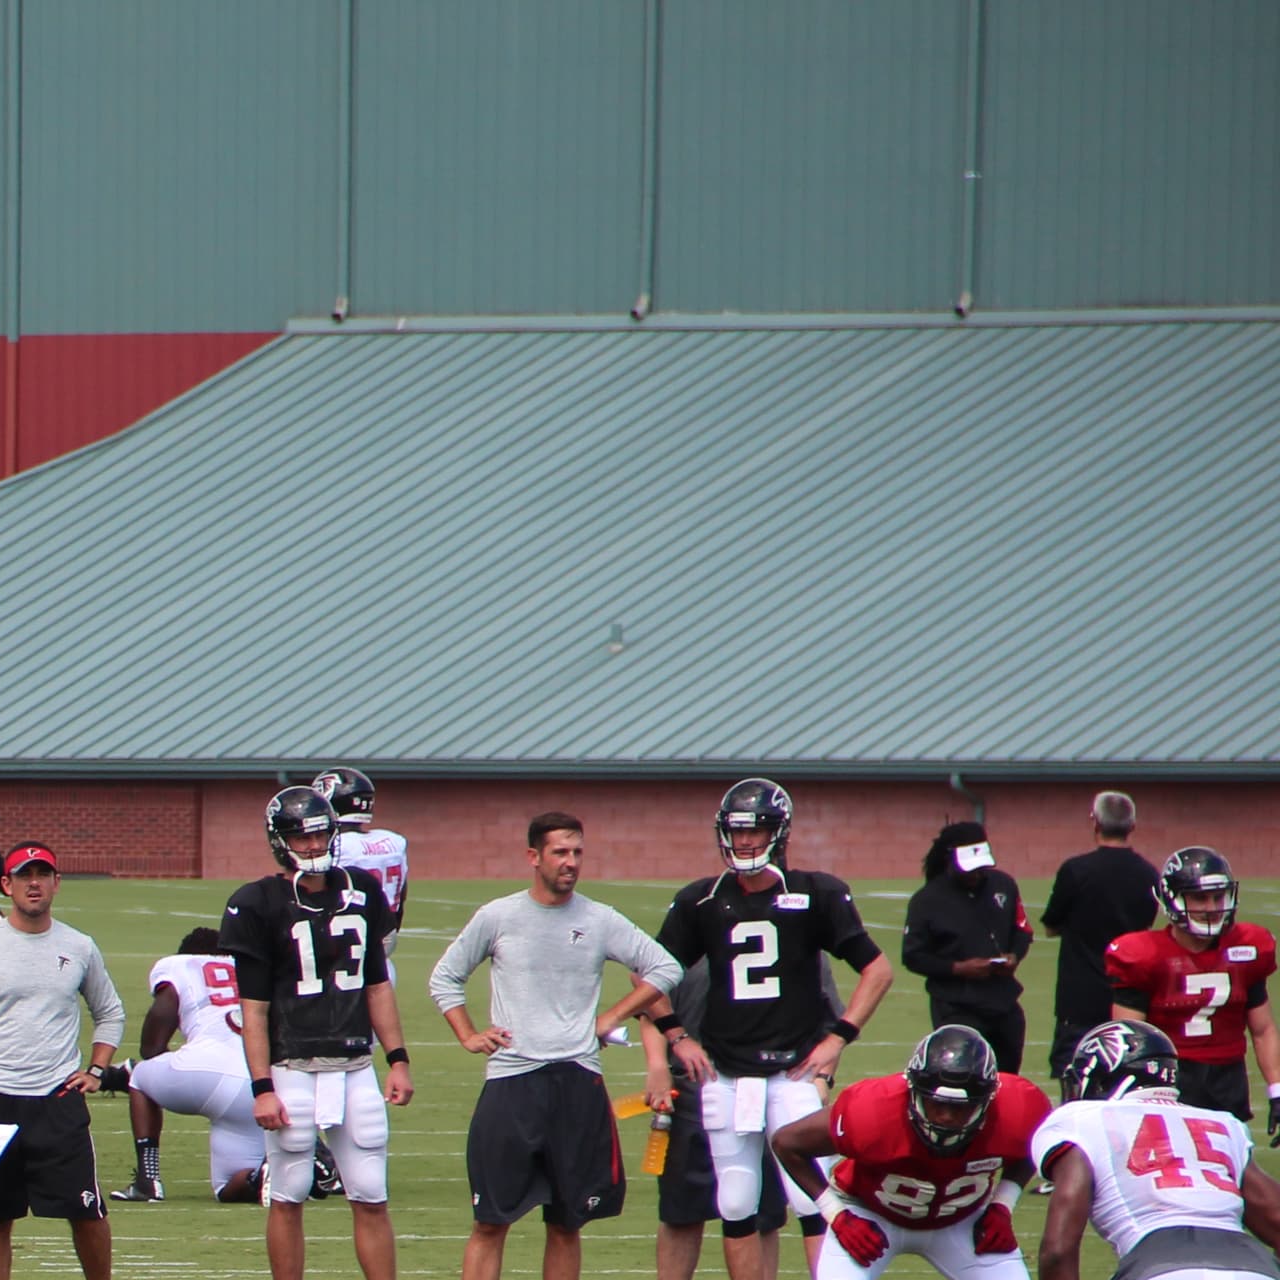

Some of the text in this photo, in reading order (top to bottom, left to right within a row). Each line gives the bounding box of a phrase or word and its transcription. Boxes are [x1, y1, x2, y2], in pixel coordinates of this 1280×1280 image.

[291, 914, 368, 995] 13
[731, 920, 781, 1000] 2
[1184, 972, 1231, 1036] 7
[1161, 1068, 1176, 1083] 45
[1127, 1114, 1242, 1197] 45
